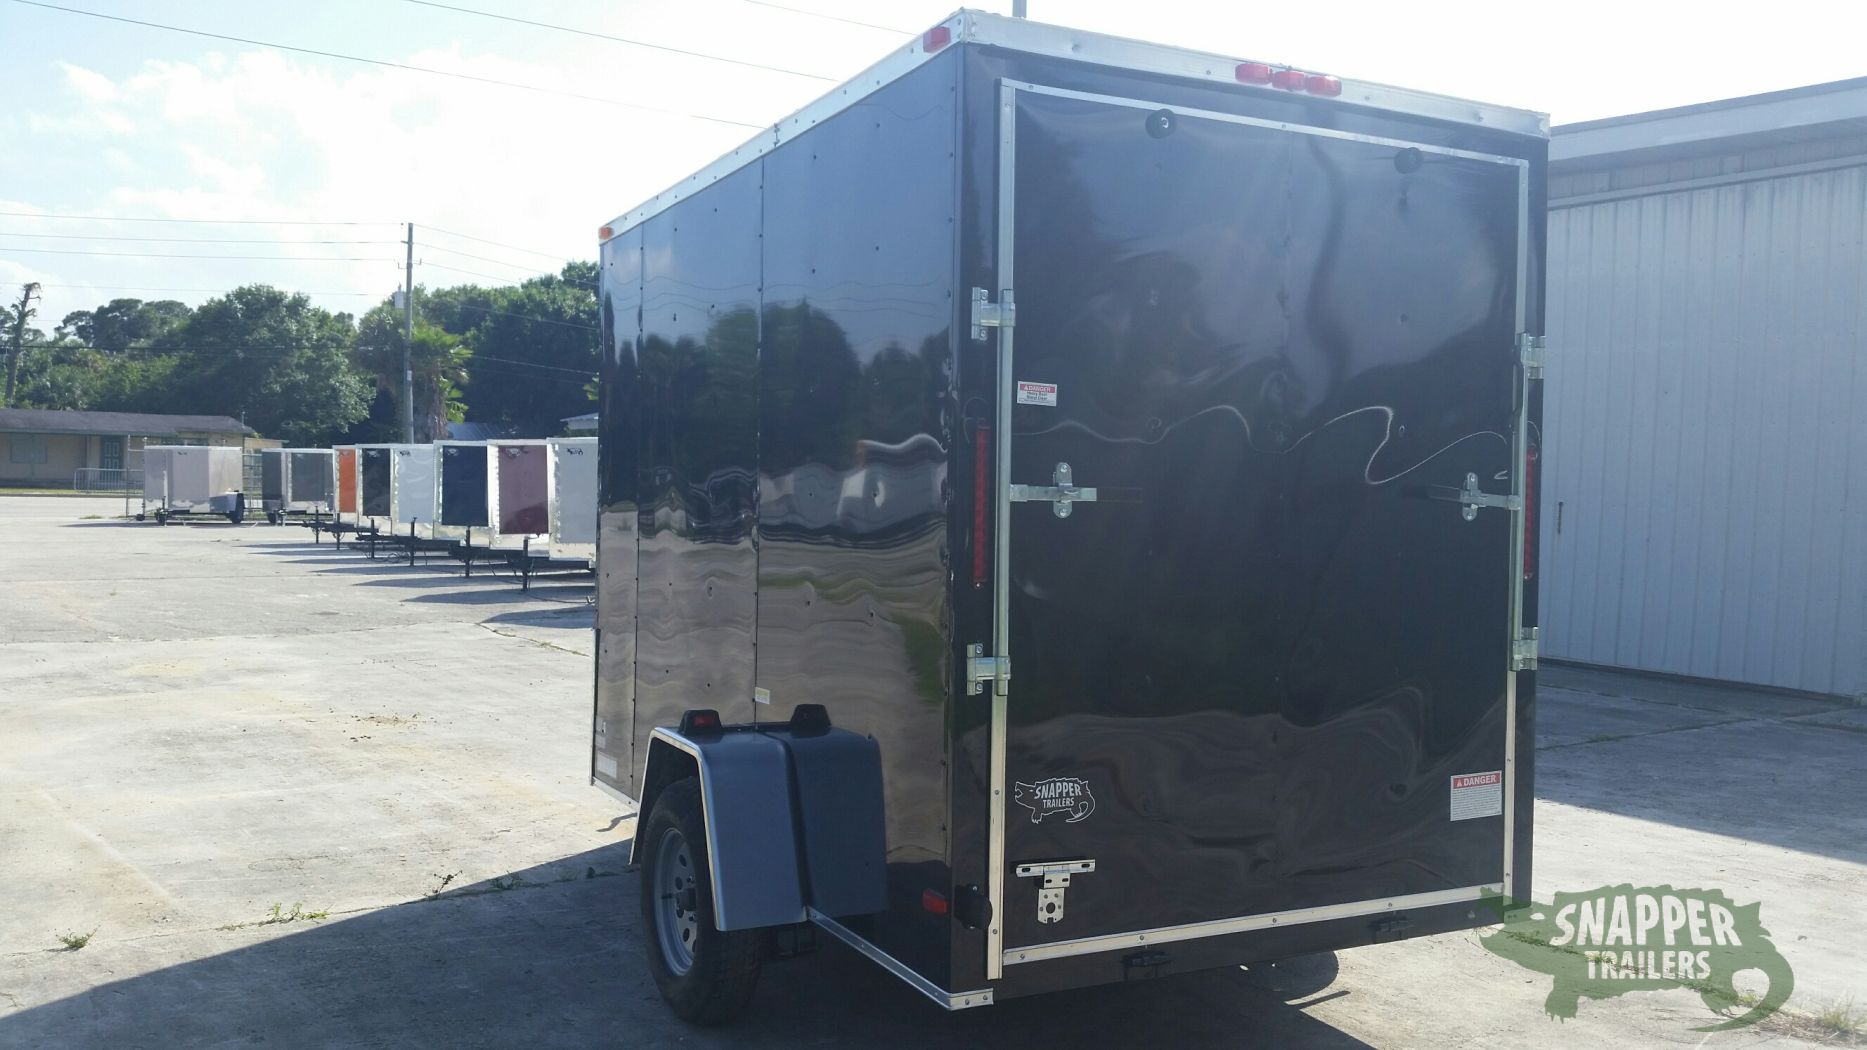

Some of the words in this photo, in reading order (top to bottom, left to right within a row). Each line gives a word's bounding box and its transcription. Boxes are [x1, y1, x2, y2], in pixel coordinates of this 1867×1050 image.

[1463, 774, 1497, 786] DANGER
[1034, 782, 1082, 799] SNAPPER
[1043, 797, 1075, 808] TRAILERS
